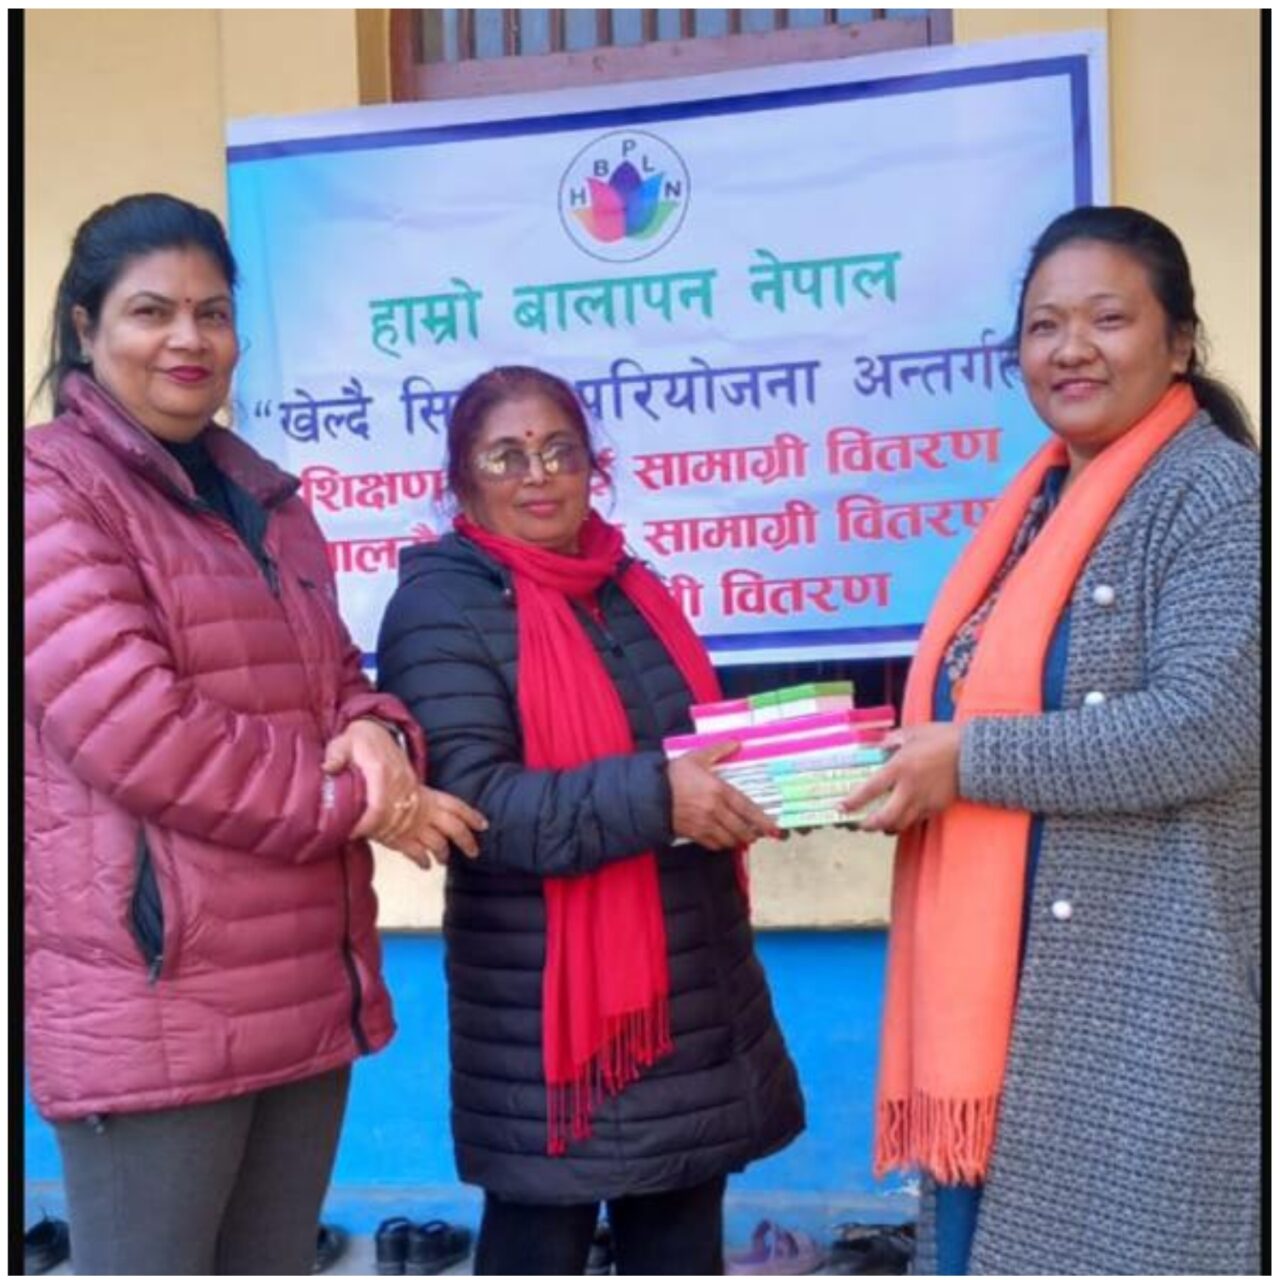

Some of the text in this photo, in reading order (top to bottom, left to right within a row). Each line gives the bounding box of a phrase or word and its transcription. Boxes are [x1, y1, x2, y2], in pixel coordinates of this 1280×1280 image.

[369, 249, 901, 358] हाम्रो बालापन नेपाल
[575, 357, 820, 421] परियोजना
[301, 465, 445, 512] शिक्षण
[634, 433, 808, 490] सामाग्री
[827, 427, 1002, 474] वितरण
[645, 499, 818, 556] सामाग्री
[721, 568, 892, 617] वितरण
